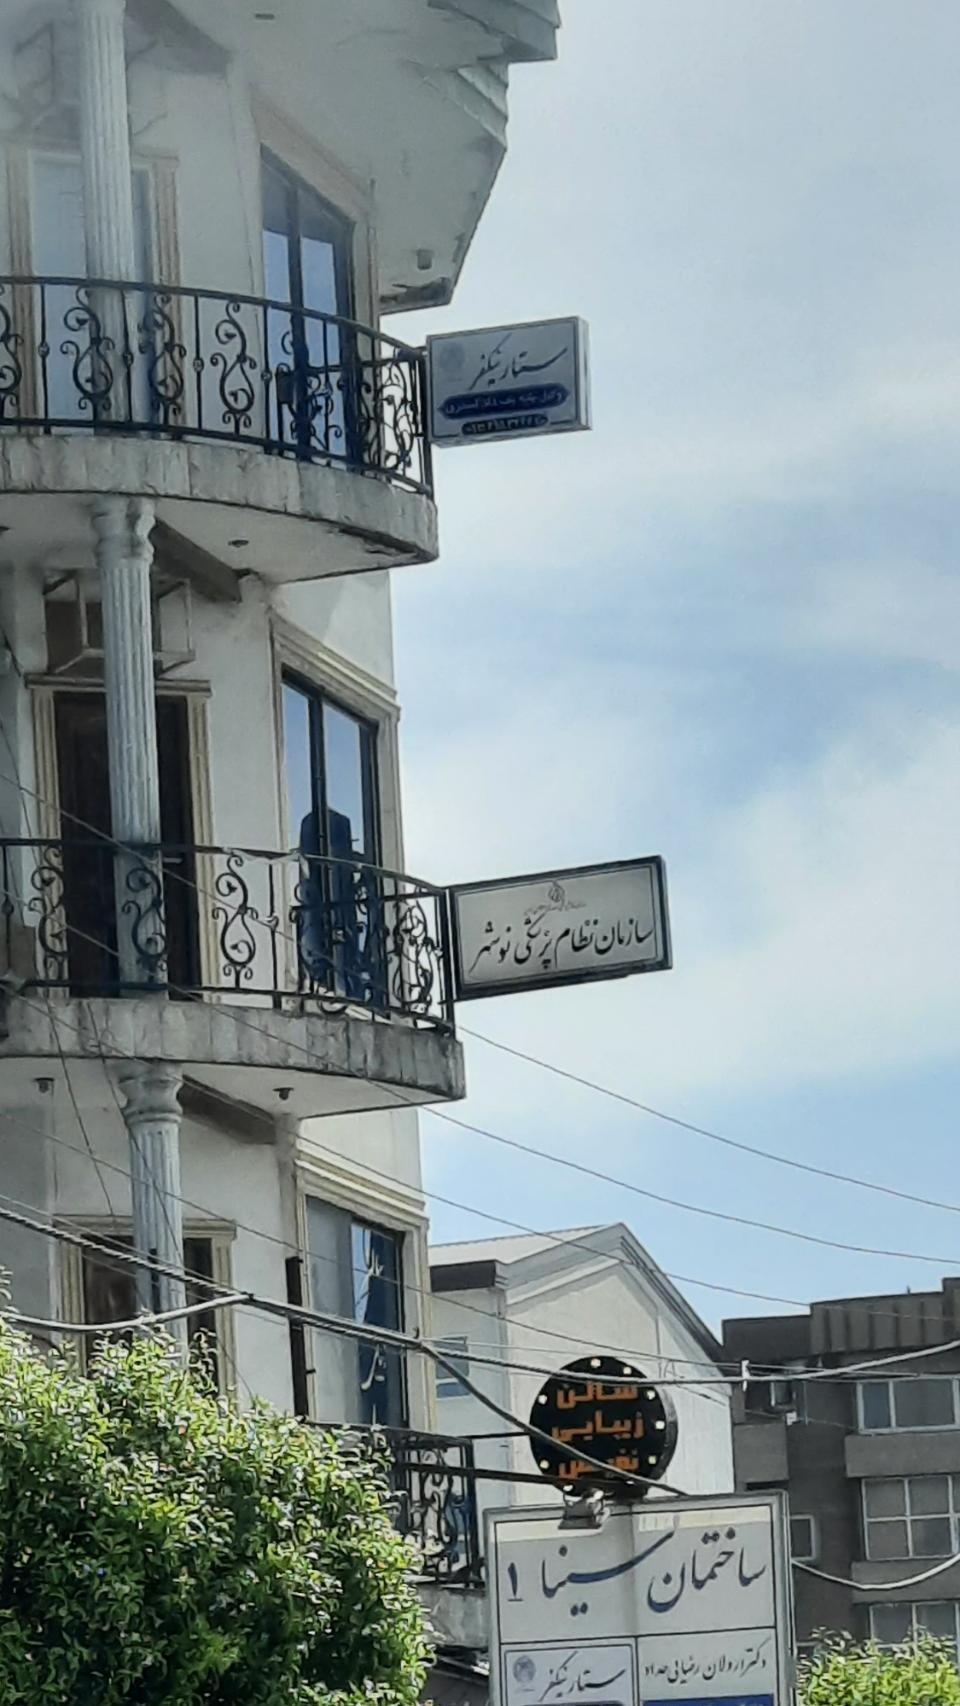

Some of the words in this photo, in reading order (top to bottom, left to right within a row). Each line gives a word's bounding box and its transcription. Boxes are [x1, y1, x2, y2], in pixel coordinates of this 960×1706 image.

[468, 920, 512, 975] نوشهر
[513, 909, 554, 969] پزشکی
[555, 918, 599, 969] نظام
[595, 917, 655, 954] سازمان
[556, 1379, 639, 1410] سالن
[551, 1410, 645, 1442] زیبایی
[541, 1526, 676, 1617] سینا
[646, 1527, 767, 1614] ساختمان
[739, 1636, 772, 1678] دکتر
